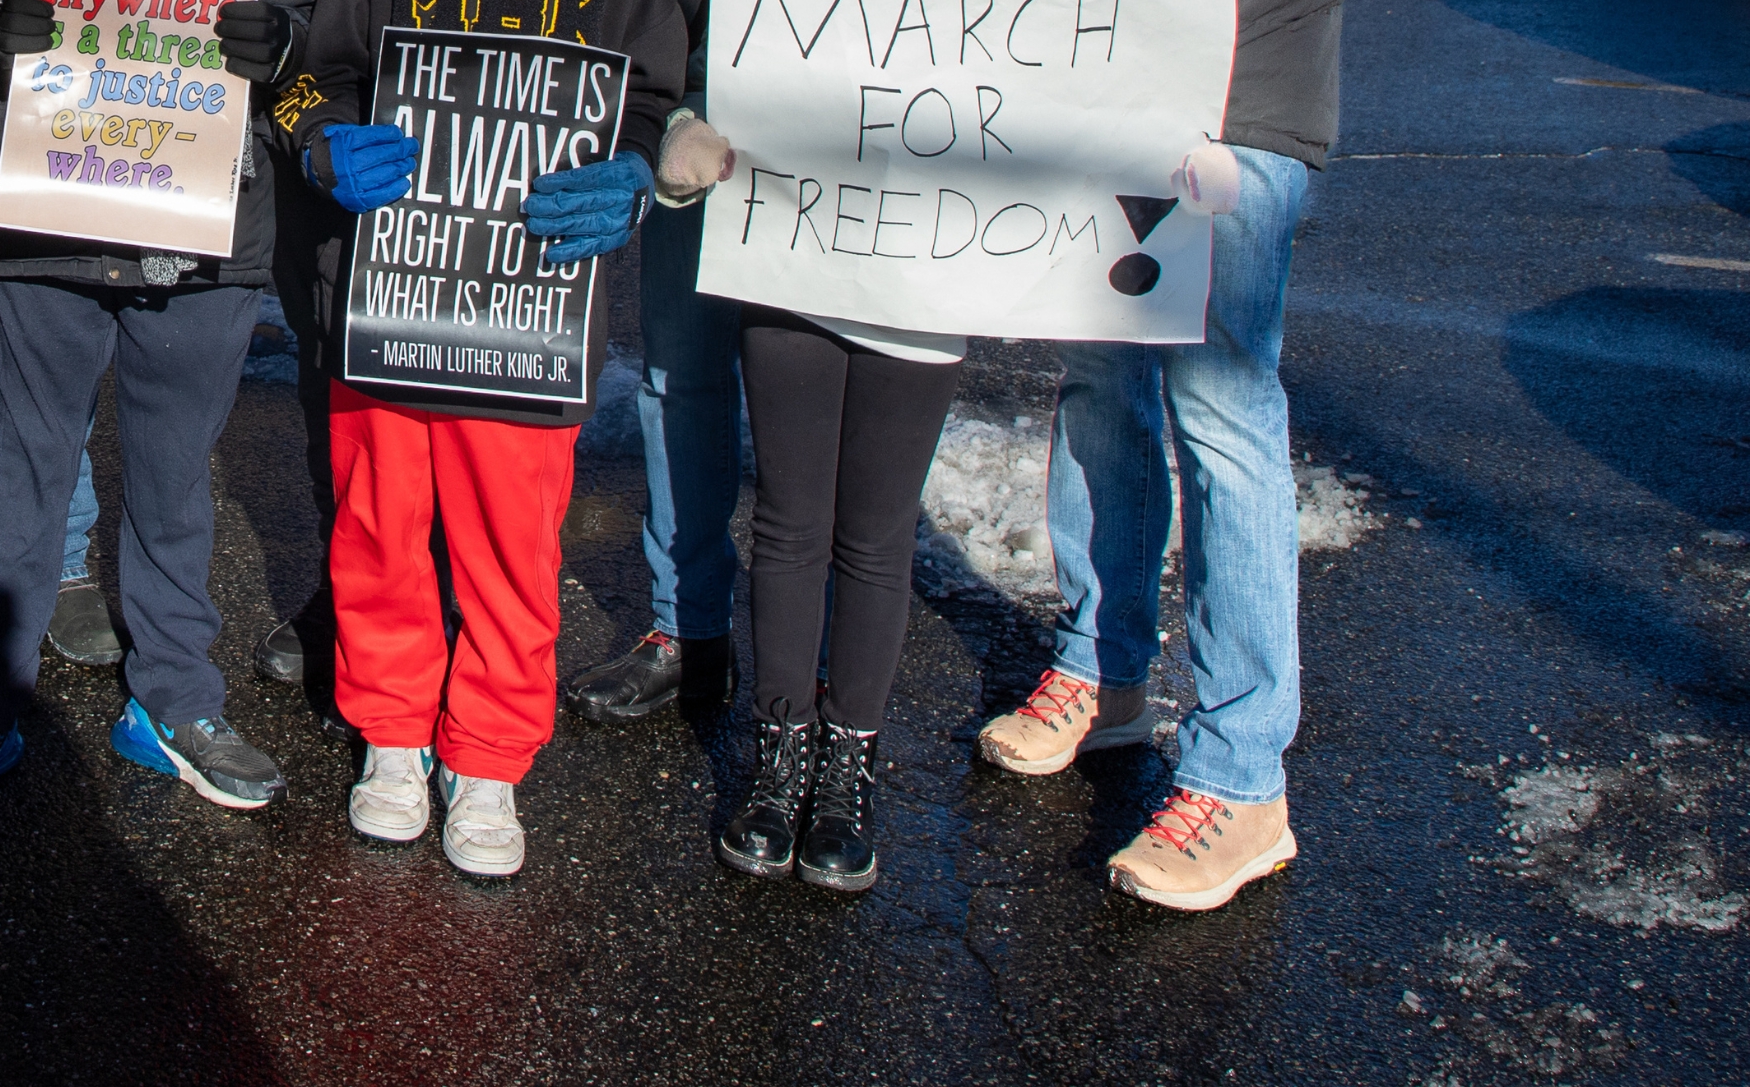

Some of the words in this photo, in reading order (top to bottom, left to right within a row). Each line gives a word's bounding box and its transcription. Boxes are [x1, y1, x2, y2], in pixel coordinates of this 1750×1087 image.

[50, 21, 64, 50] s
[77, 24, 100, 54] a
[115, 20, 224, 70] threa
[31, 56, 73, 94] to
[79, 58, 226, 113] justice
[395, 42, 461, 102] THE
[476, 49, 564, 117] TIME
[576, 60, 612, 123] IS
[51, 109, 197, 159] every-
[857, 85, 1012, 162] FOR
[46, 146, 184, 195] where.
[370, 206, 474, 271] RIGHT
[486, 220, 527, 276] TO
[365, 269, 446, 322] WHAT
[453, 279, 481, 327] IS
[489, 282, 572, 335] RIGHT.
[384, 340, 442, 371] MARTIN
[448, 346, 503, 377] LUTHER
[507, 352, 543, 380] KING
[548, 358, 571, 383] JR.
